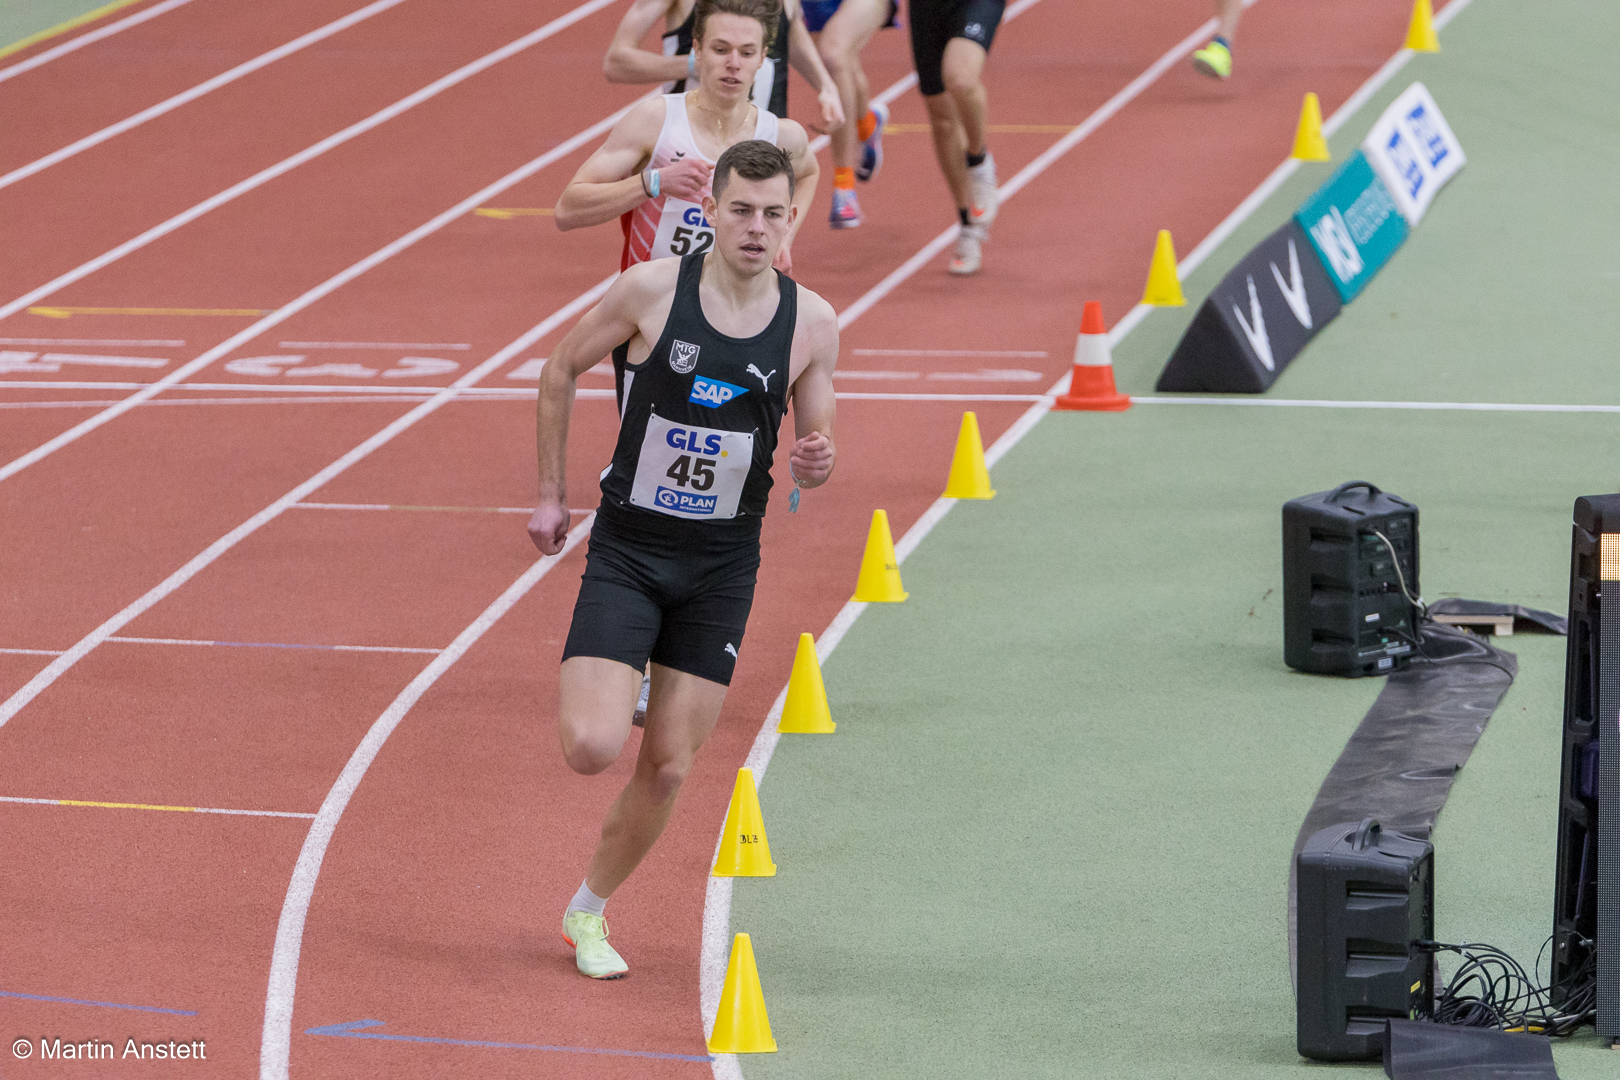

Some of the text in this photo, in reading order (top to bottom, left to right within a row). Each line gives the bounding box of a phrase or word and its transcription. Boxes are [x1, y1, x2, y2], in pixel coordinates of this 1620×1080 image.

[676, 342, 696, 354] MTG
[691, 381, 733, 404] SAP
[666, 454, 717, 491] 45
[680, 495, 714, 508] PLAN
